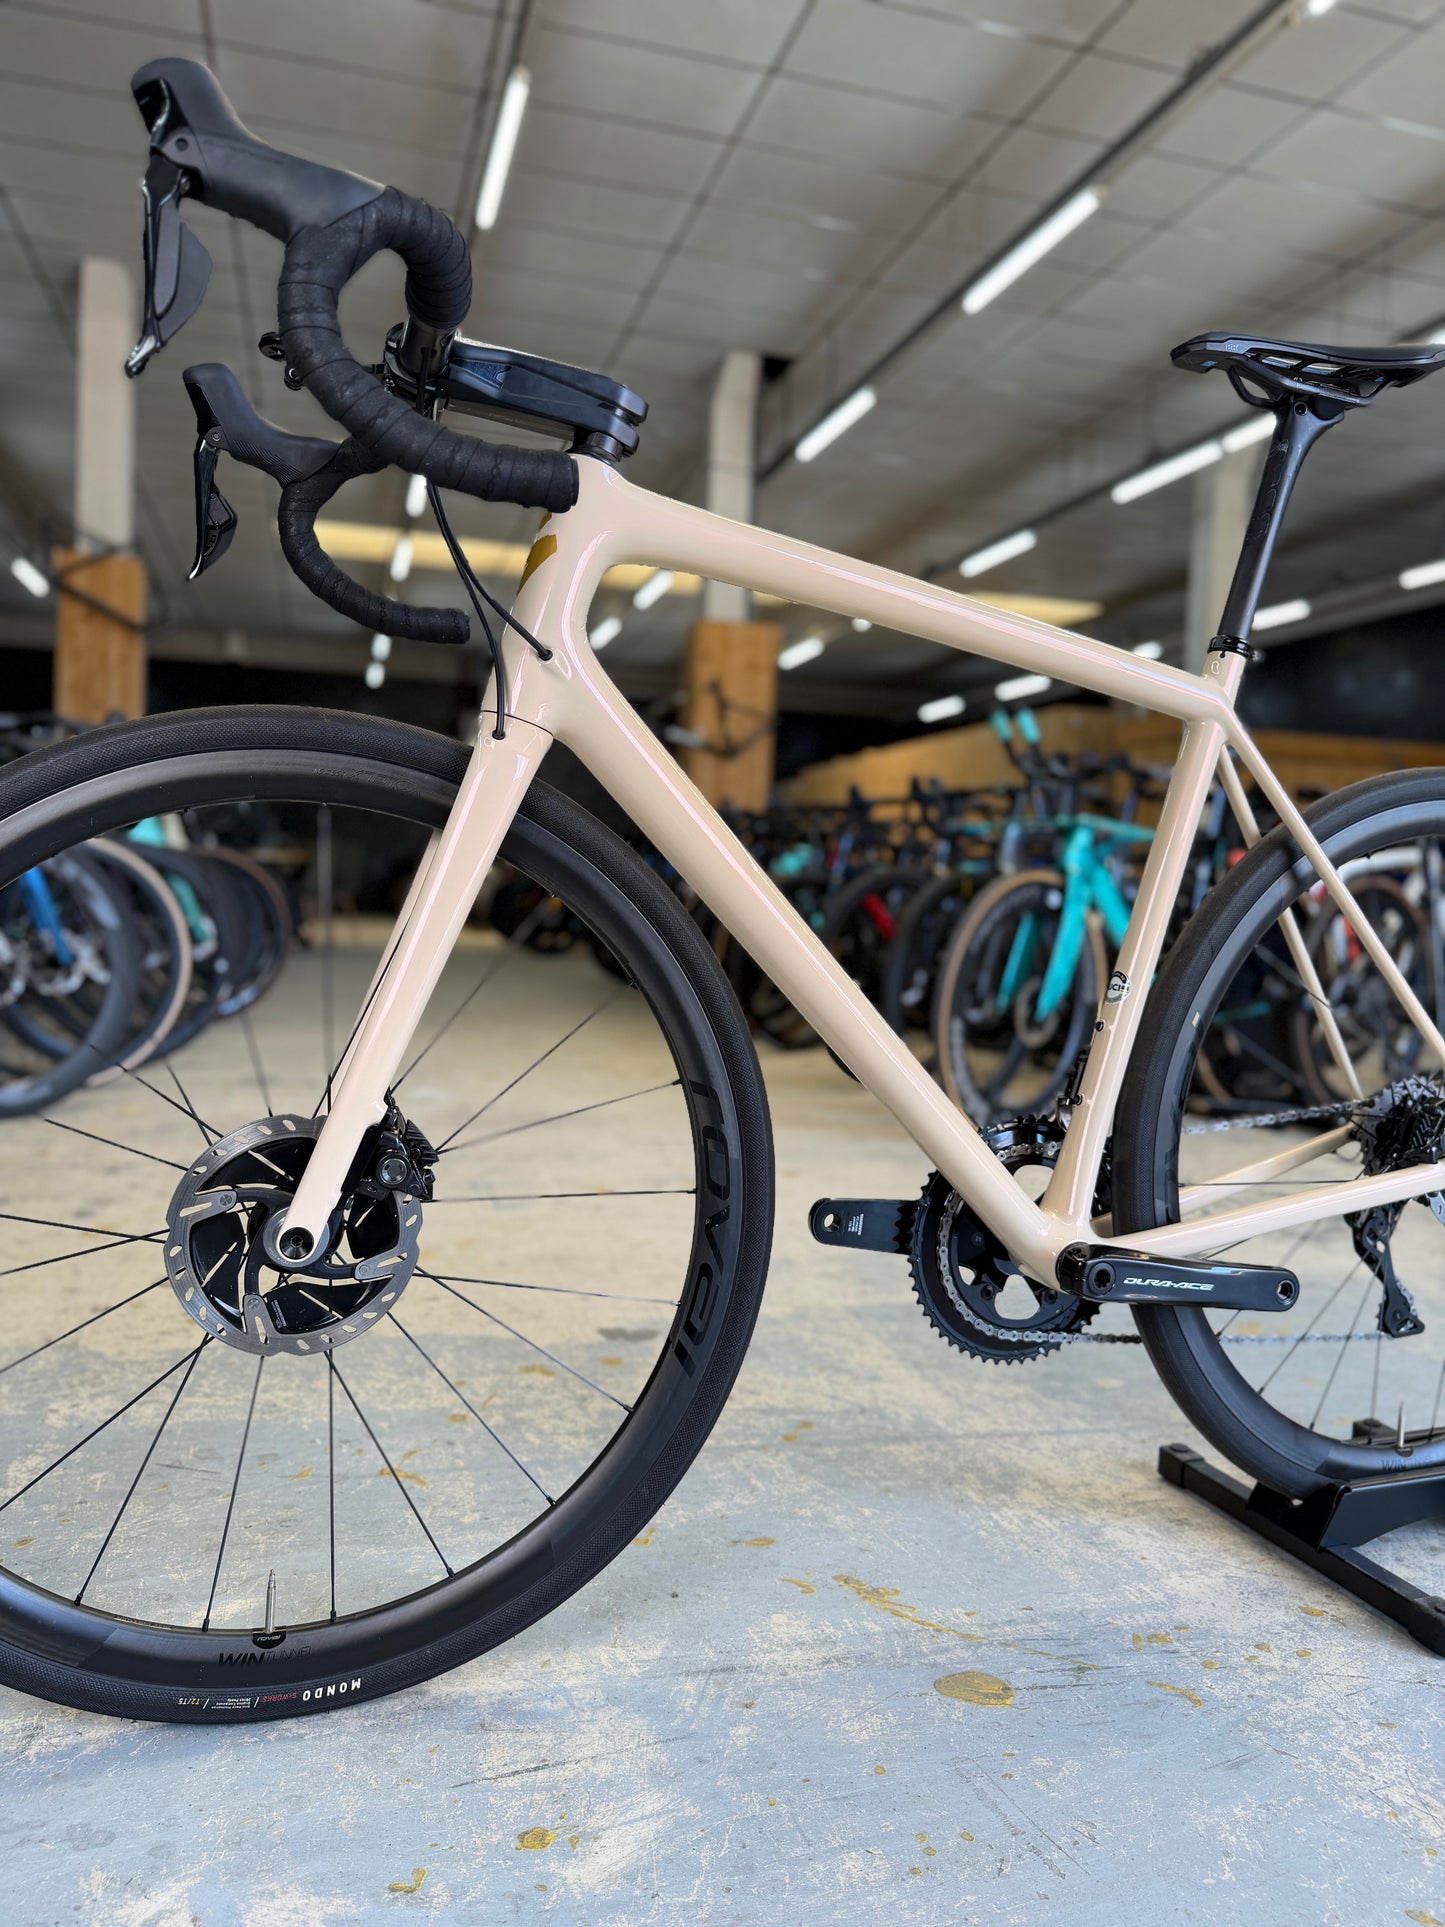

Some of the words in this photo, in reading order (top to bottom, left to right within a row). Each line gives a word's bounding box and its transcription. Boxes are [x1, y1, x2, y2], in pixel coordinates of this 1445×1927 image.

[1123, 1277, 1215, 1292] DURA-ACE
[262, 1691, 297, 1703] S-WORKS
[302, 1677, 362, 1702] MONDO
